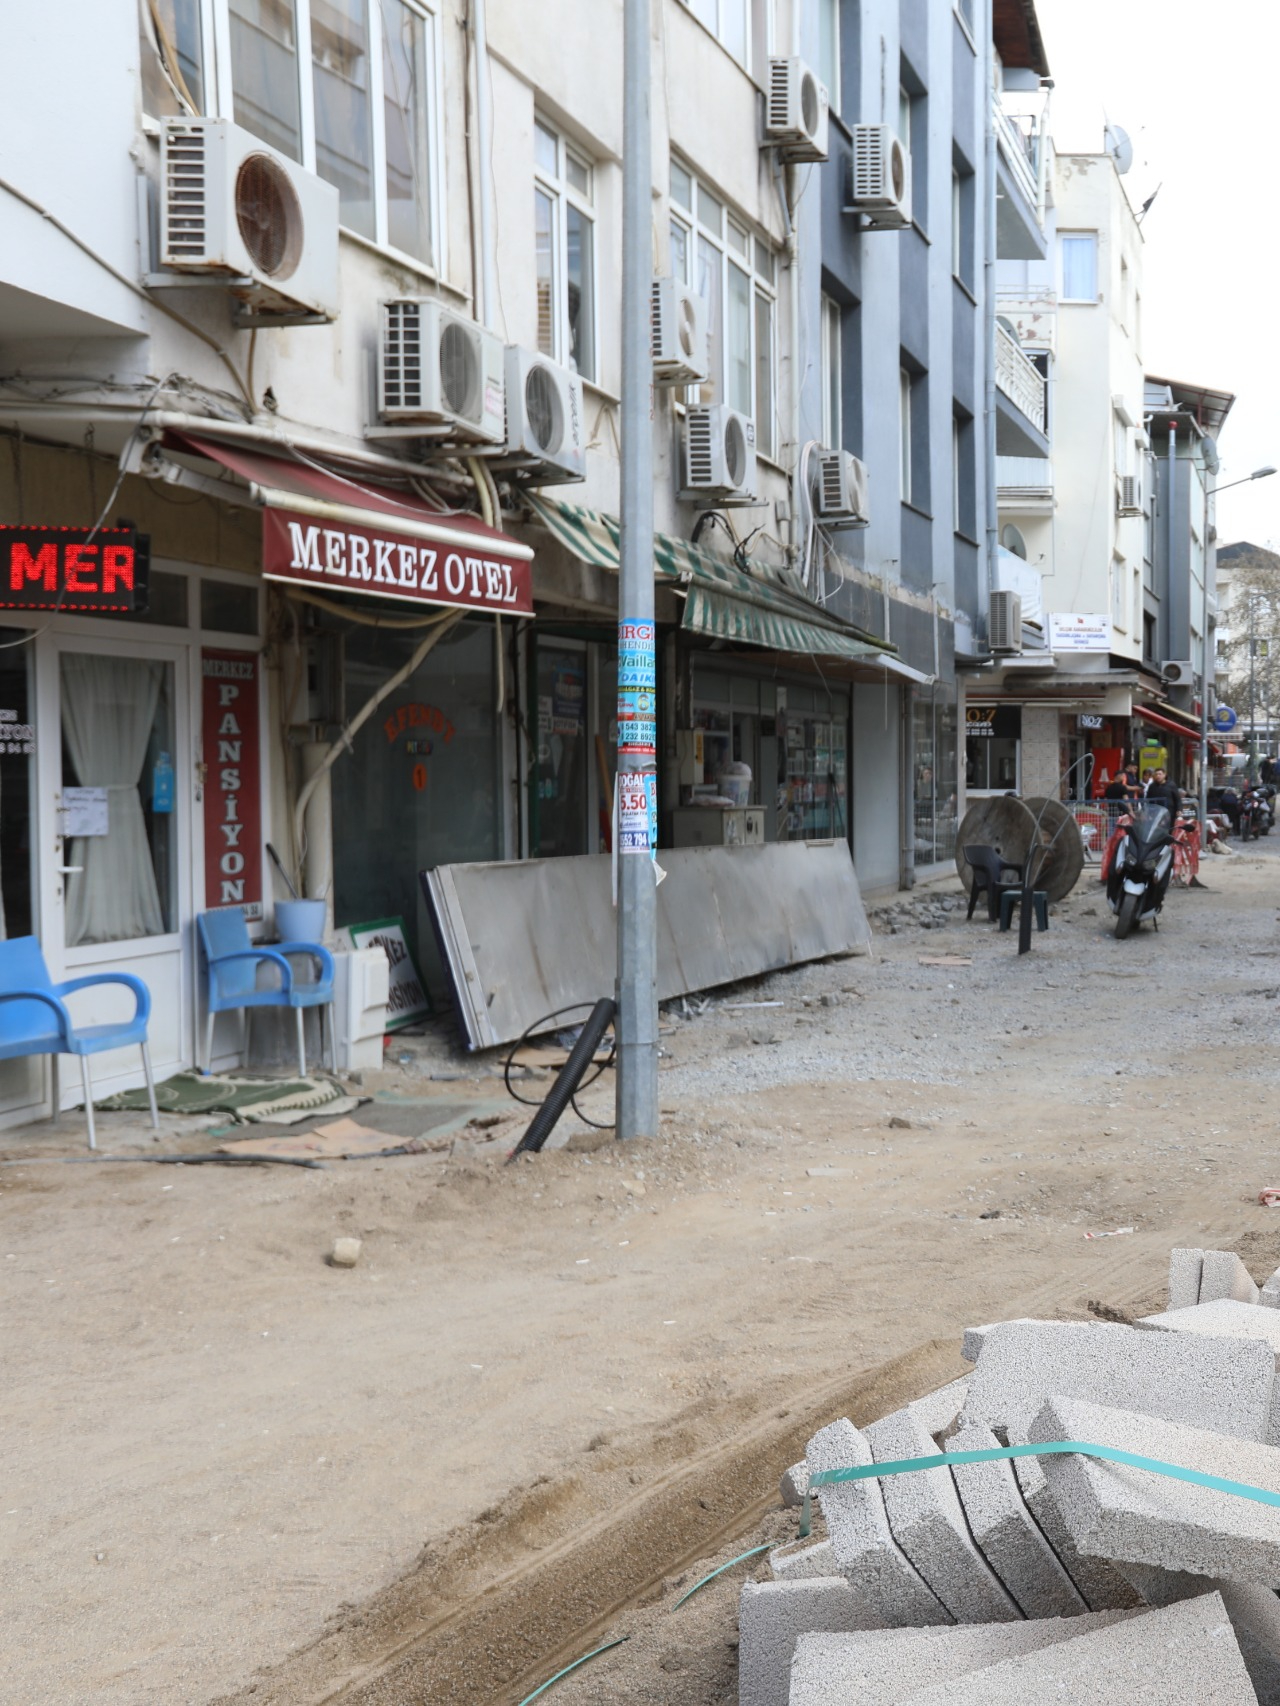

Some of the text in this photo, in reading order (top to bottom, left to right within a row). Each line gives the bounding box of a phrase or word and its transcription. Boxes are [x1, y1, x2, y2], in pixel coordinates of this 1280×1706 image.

[10, 542, 135, 593] MER
[287, 521, 518, 603] MERKEZ OTEL
[203, 659, 254, 679] MERKEZ
[218, 684, 244, 903] PANSİYON
